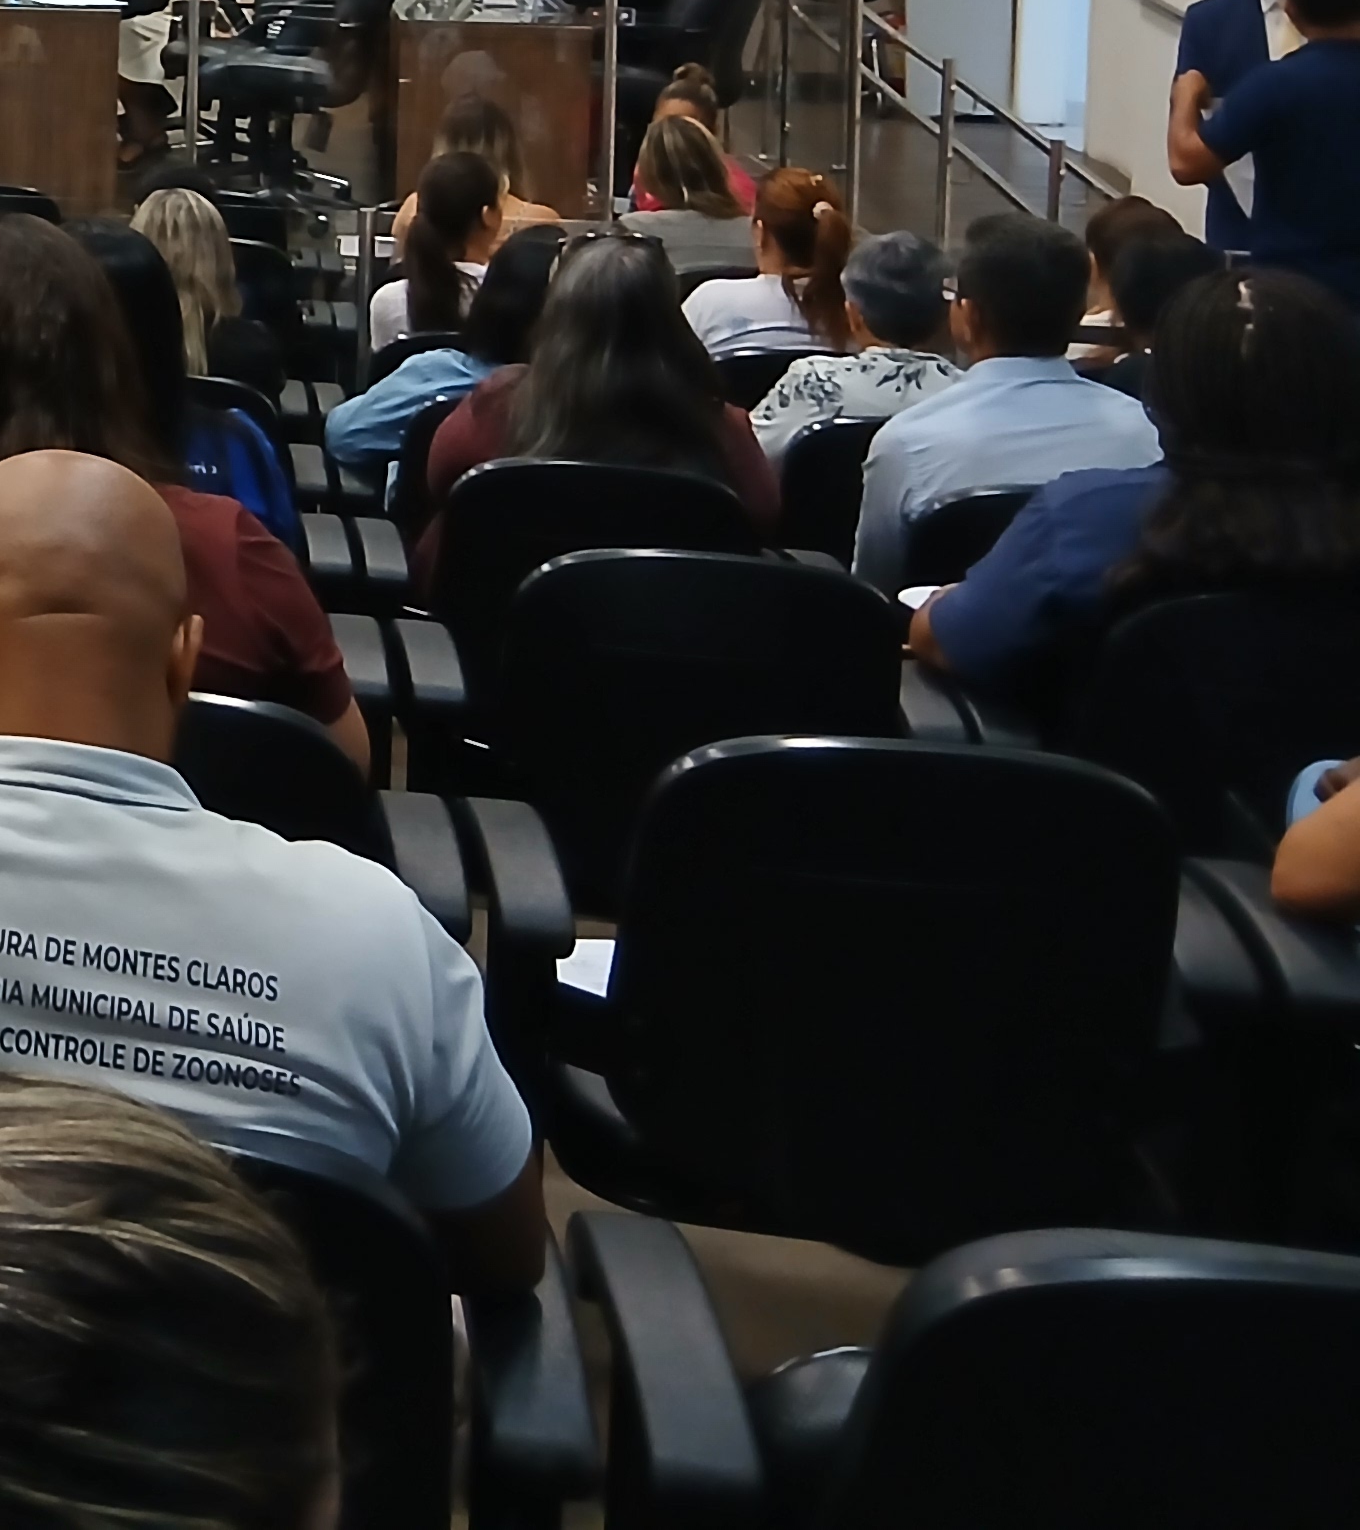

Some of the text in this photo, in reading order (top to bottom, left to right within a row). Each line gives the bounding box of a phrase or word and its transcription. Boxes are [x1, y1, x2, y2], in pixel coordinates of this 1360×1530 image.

[44, 937, 76, 966] DE
[82, 942, 181, 984] MONTES
[186, 960, 279, 1001] CLAROS
[30, 984, 160, 1028] MUNICIPAL
[168, 1006, 200, 1035] DE
[206, 1012, 286, 1053] SAÚDE
[0, 1027, 126, 1070] CONTROLE
[133, 1046, 165, 1076] DE
[171, 1053, 301, 1097] ZOONOSES
